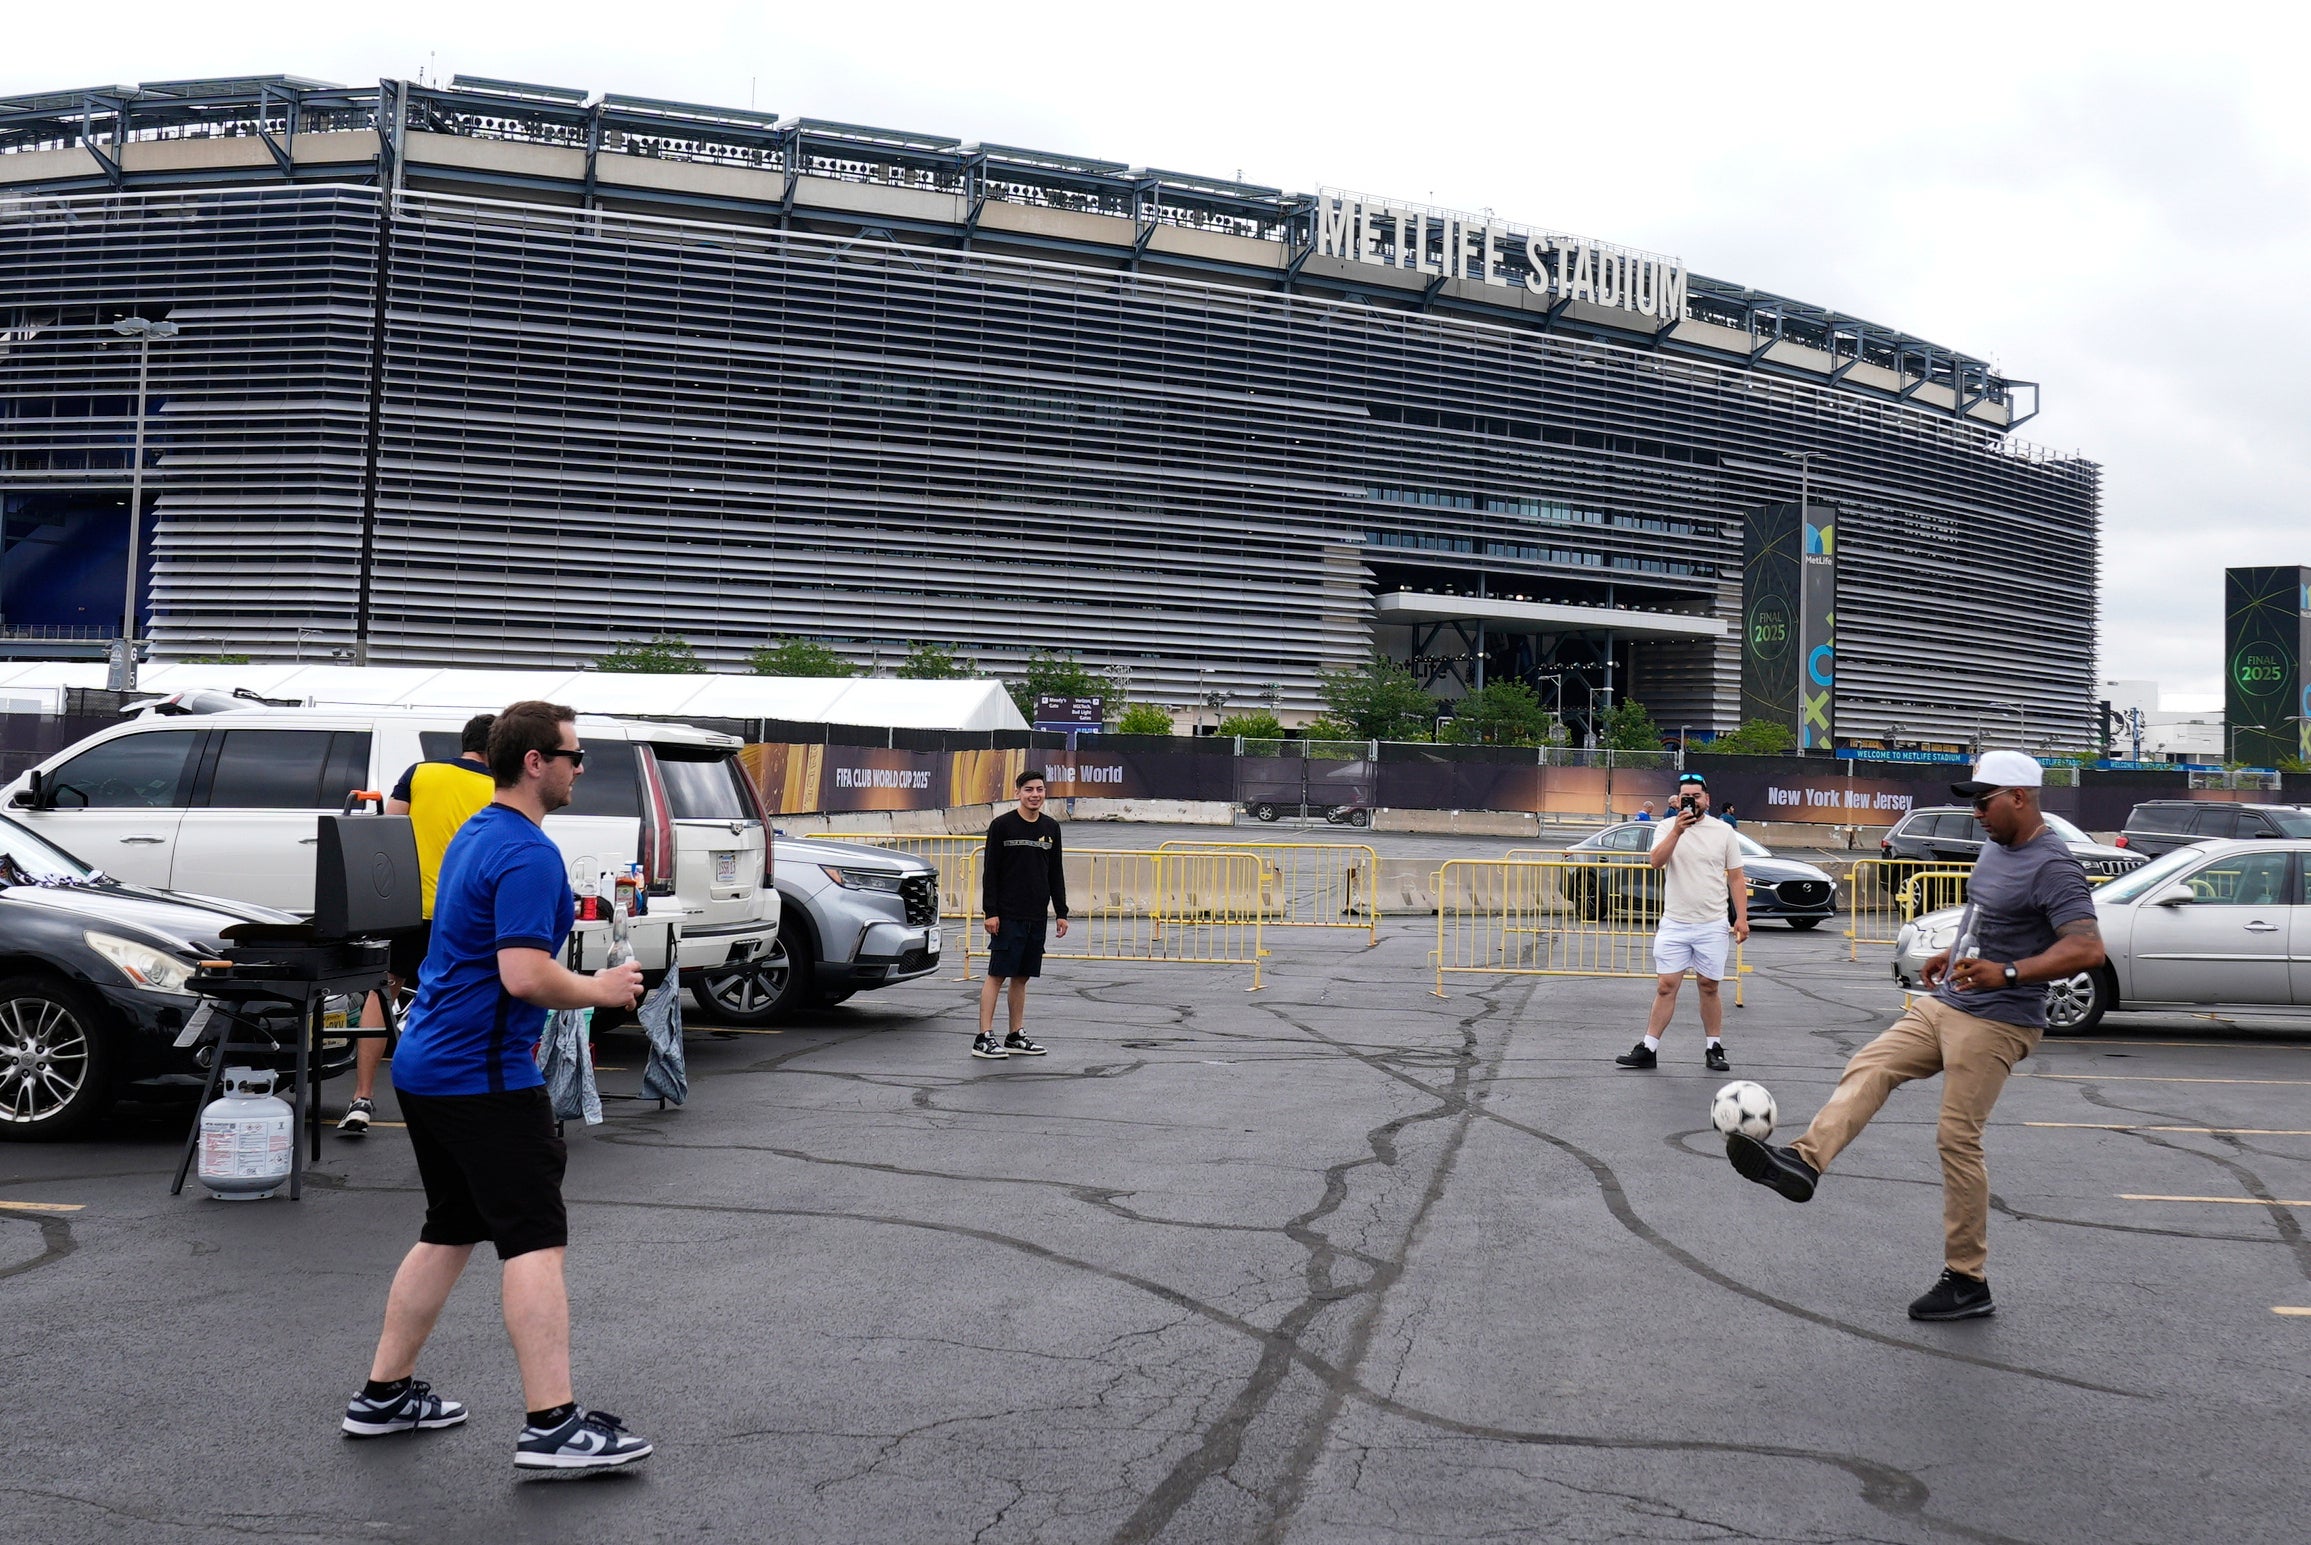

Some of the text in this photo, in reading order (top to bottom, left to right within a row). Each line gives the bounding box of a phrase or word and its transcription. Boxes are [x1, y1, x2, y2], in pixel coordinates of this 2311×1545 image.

[1317, 195, 1688, 323] METLIFE STADIUM
[1805, 556, 1833, 566] MetLife
[1759, 612, 1782, 624] FINAL
[1755, 624, 1786, 642] 2025
[131, 647, 137, 661] G
[2247, 655, 2277, 665] FINAL
[130, 672, 135, 686] 5
[2242, 666, 2282, 681] 2025
[1857, 750, 1961, 761] WELCOME TO METLIFE STADIUM
[836, 767, 852, 788] FIFA
[852, 768, 872, 788] CLUB
[872, 769, 899, 788] WORLD
[899, 770, 912, 788] CUP
[1080, 765, 1123, 783] World
[1768, 787, 1914, 814] New York New Jersey
